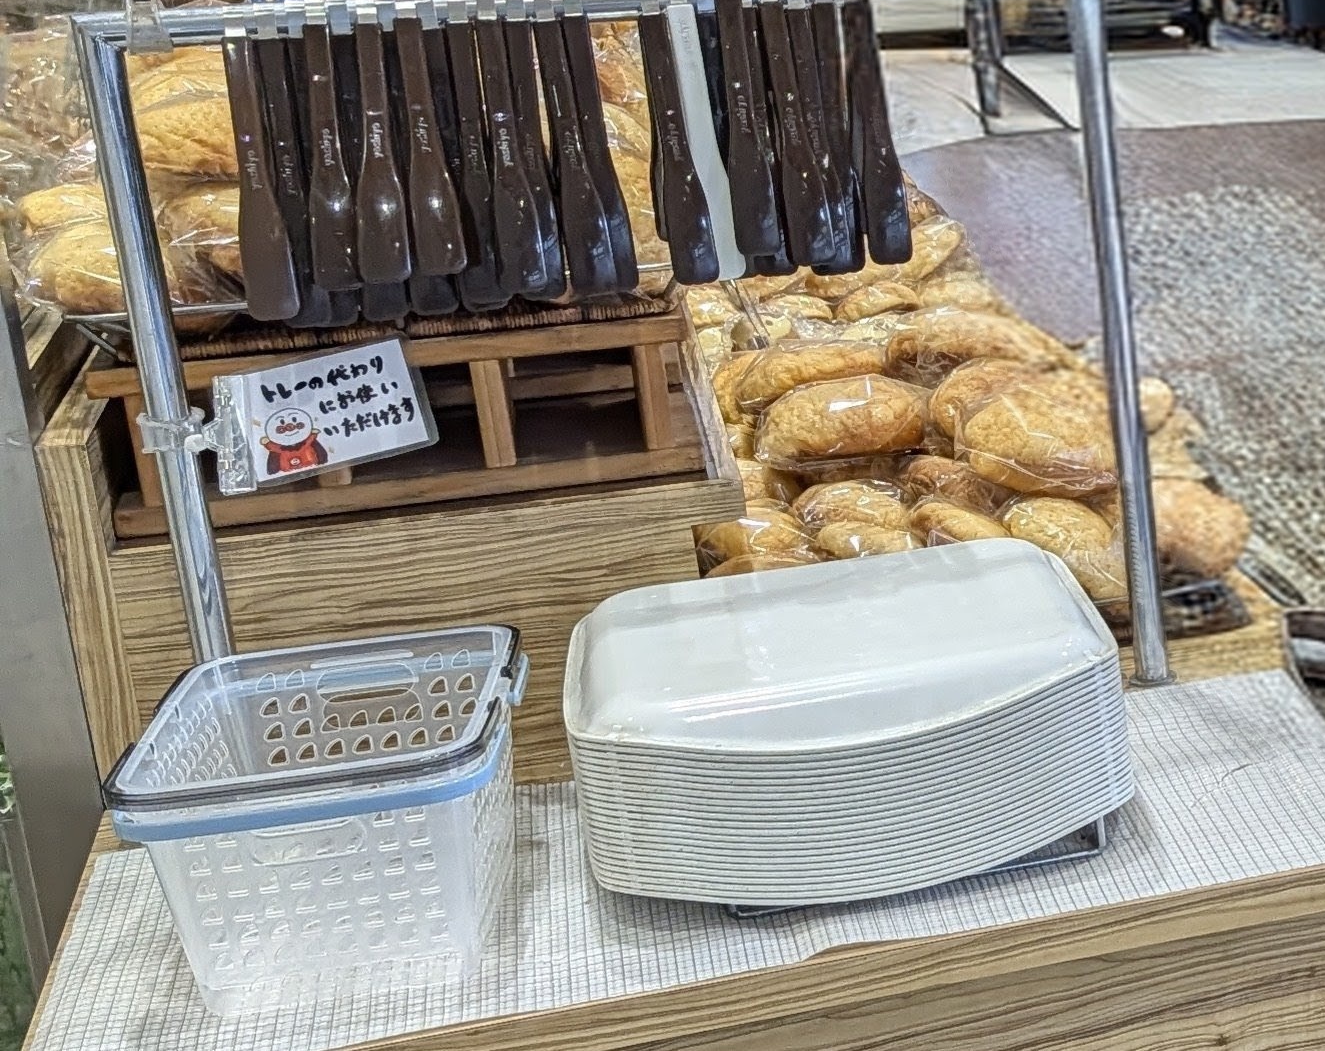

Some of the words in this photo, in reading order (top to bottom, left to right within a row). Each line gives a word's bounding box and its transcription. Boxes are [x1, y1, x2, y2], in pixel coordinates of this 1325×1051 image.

[260, 355, 384, 404] トレーの代わり
[319, 380, 399, 415] にお使い
[323, 396, 416, 438] いただけます
